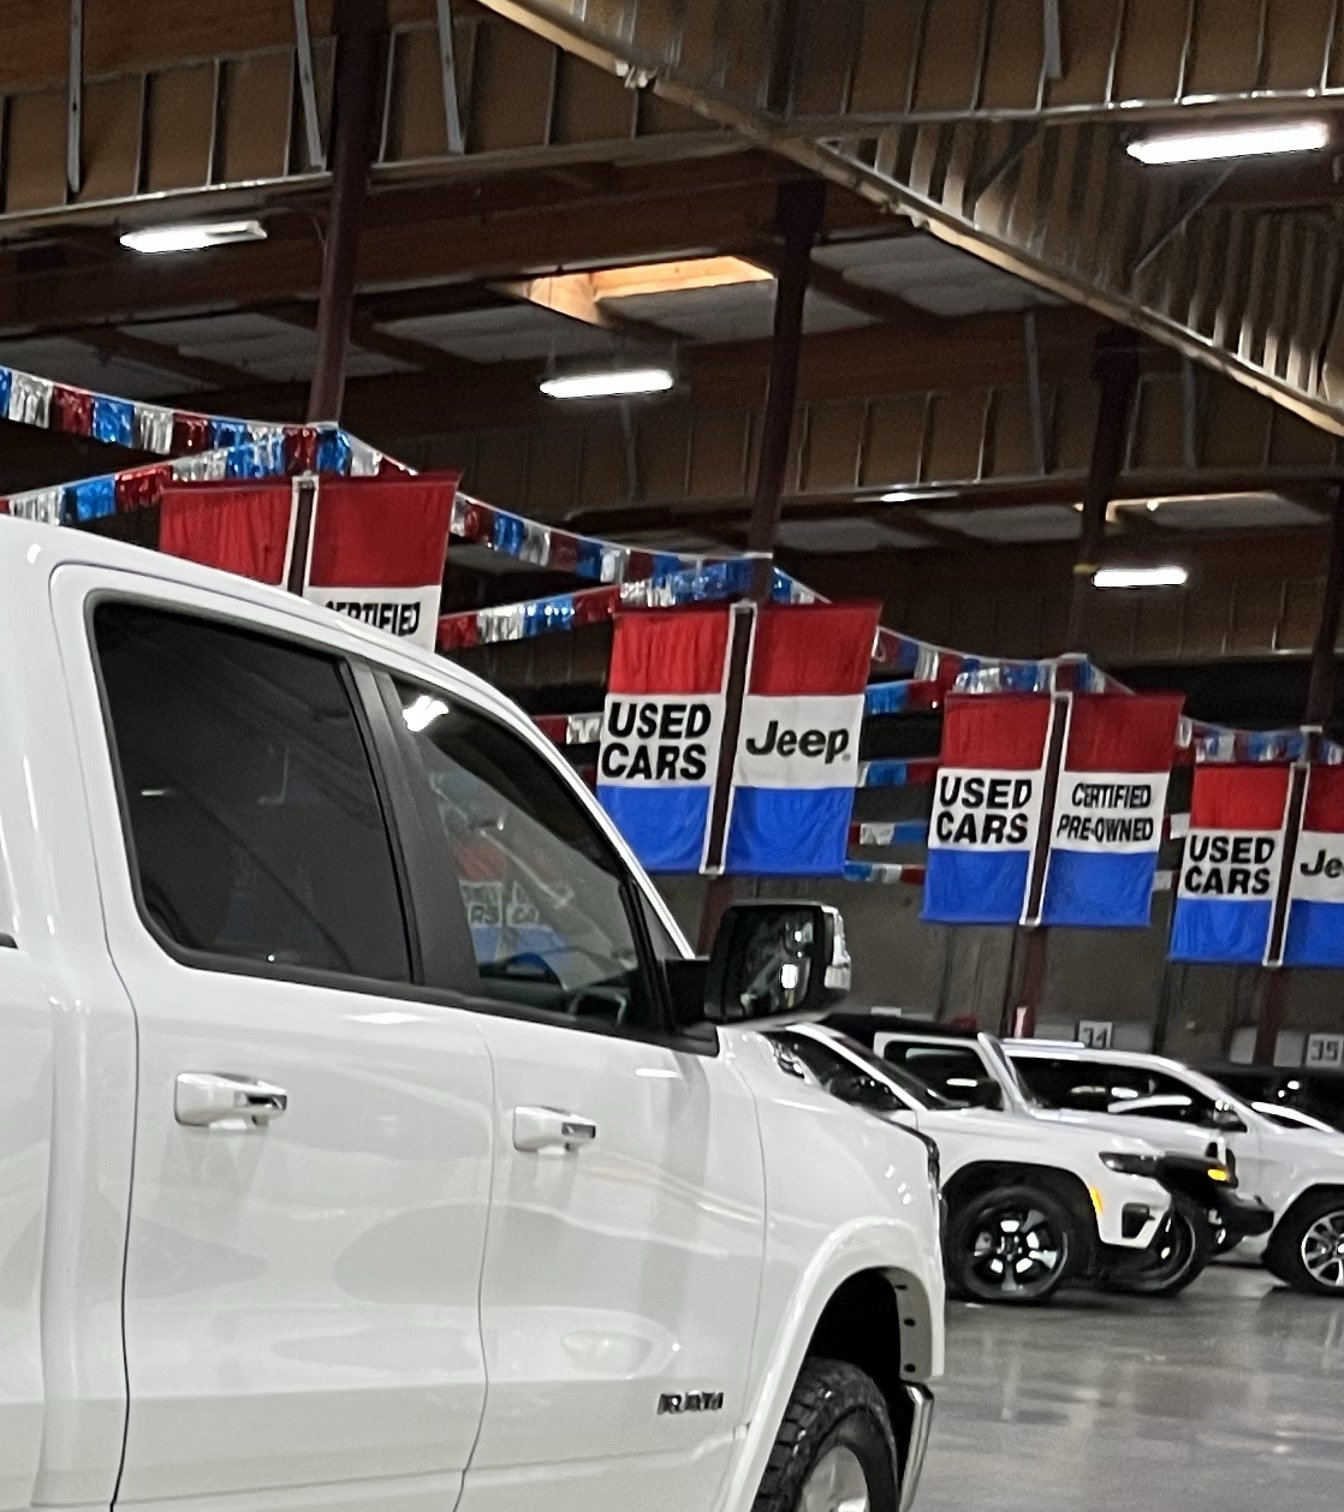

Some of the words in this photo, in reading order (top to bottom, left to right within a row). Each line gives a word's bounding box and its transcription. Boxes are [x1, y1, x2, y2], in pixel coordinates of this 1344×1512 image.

[325, 600, 421, 637] TIFIED
[608, 702, 712, 738] USED
[746, 720, 850, 764] Jeep
[602, 743, 708, 781] CARS
[939, 776, 1033, 810] USED
[1071, 782, 1153, 810] CERTIFIED
[935, 810, 1029, 844] CARS
[1056, 814, 1155, 843] PRE-OWNED
[1189, 834, 1276, 865] USED
[1184, 865, 1271, 895] CARS
